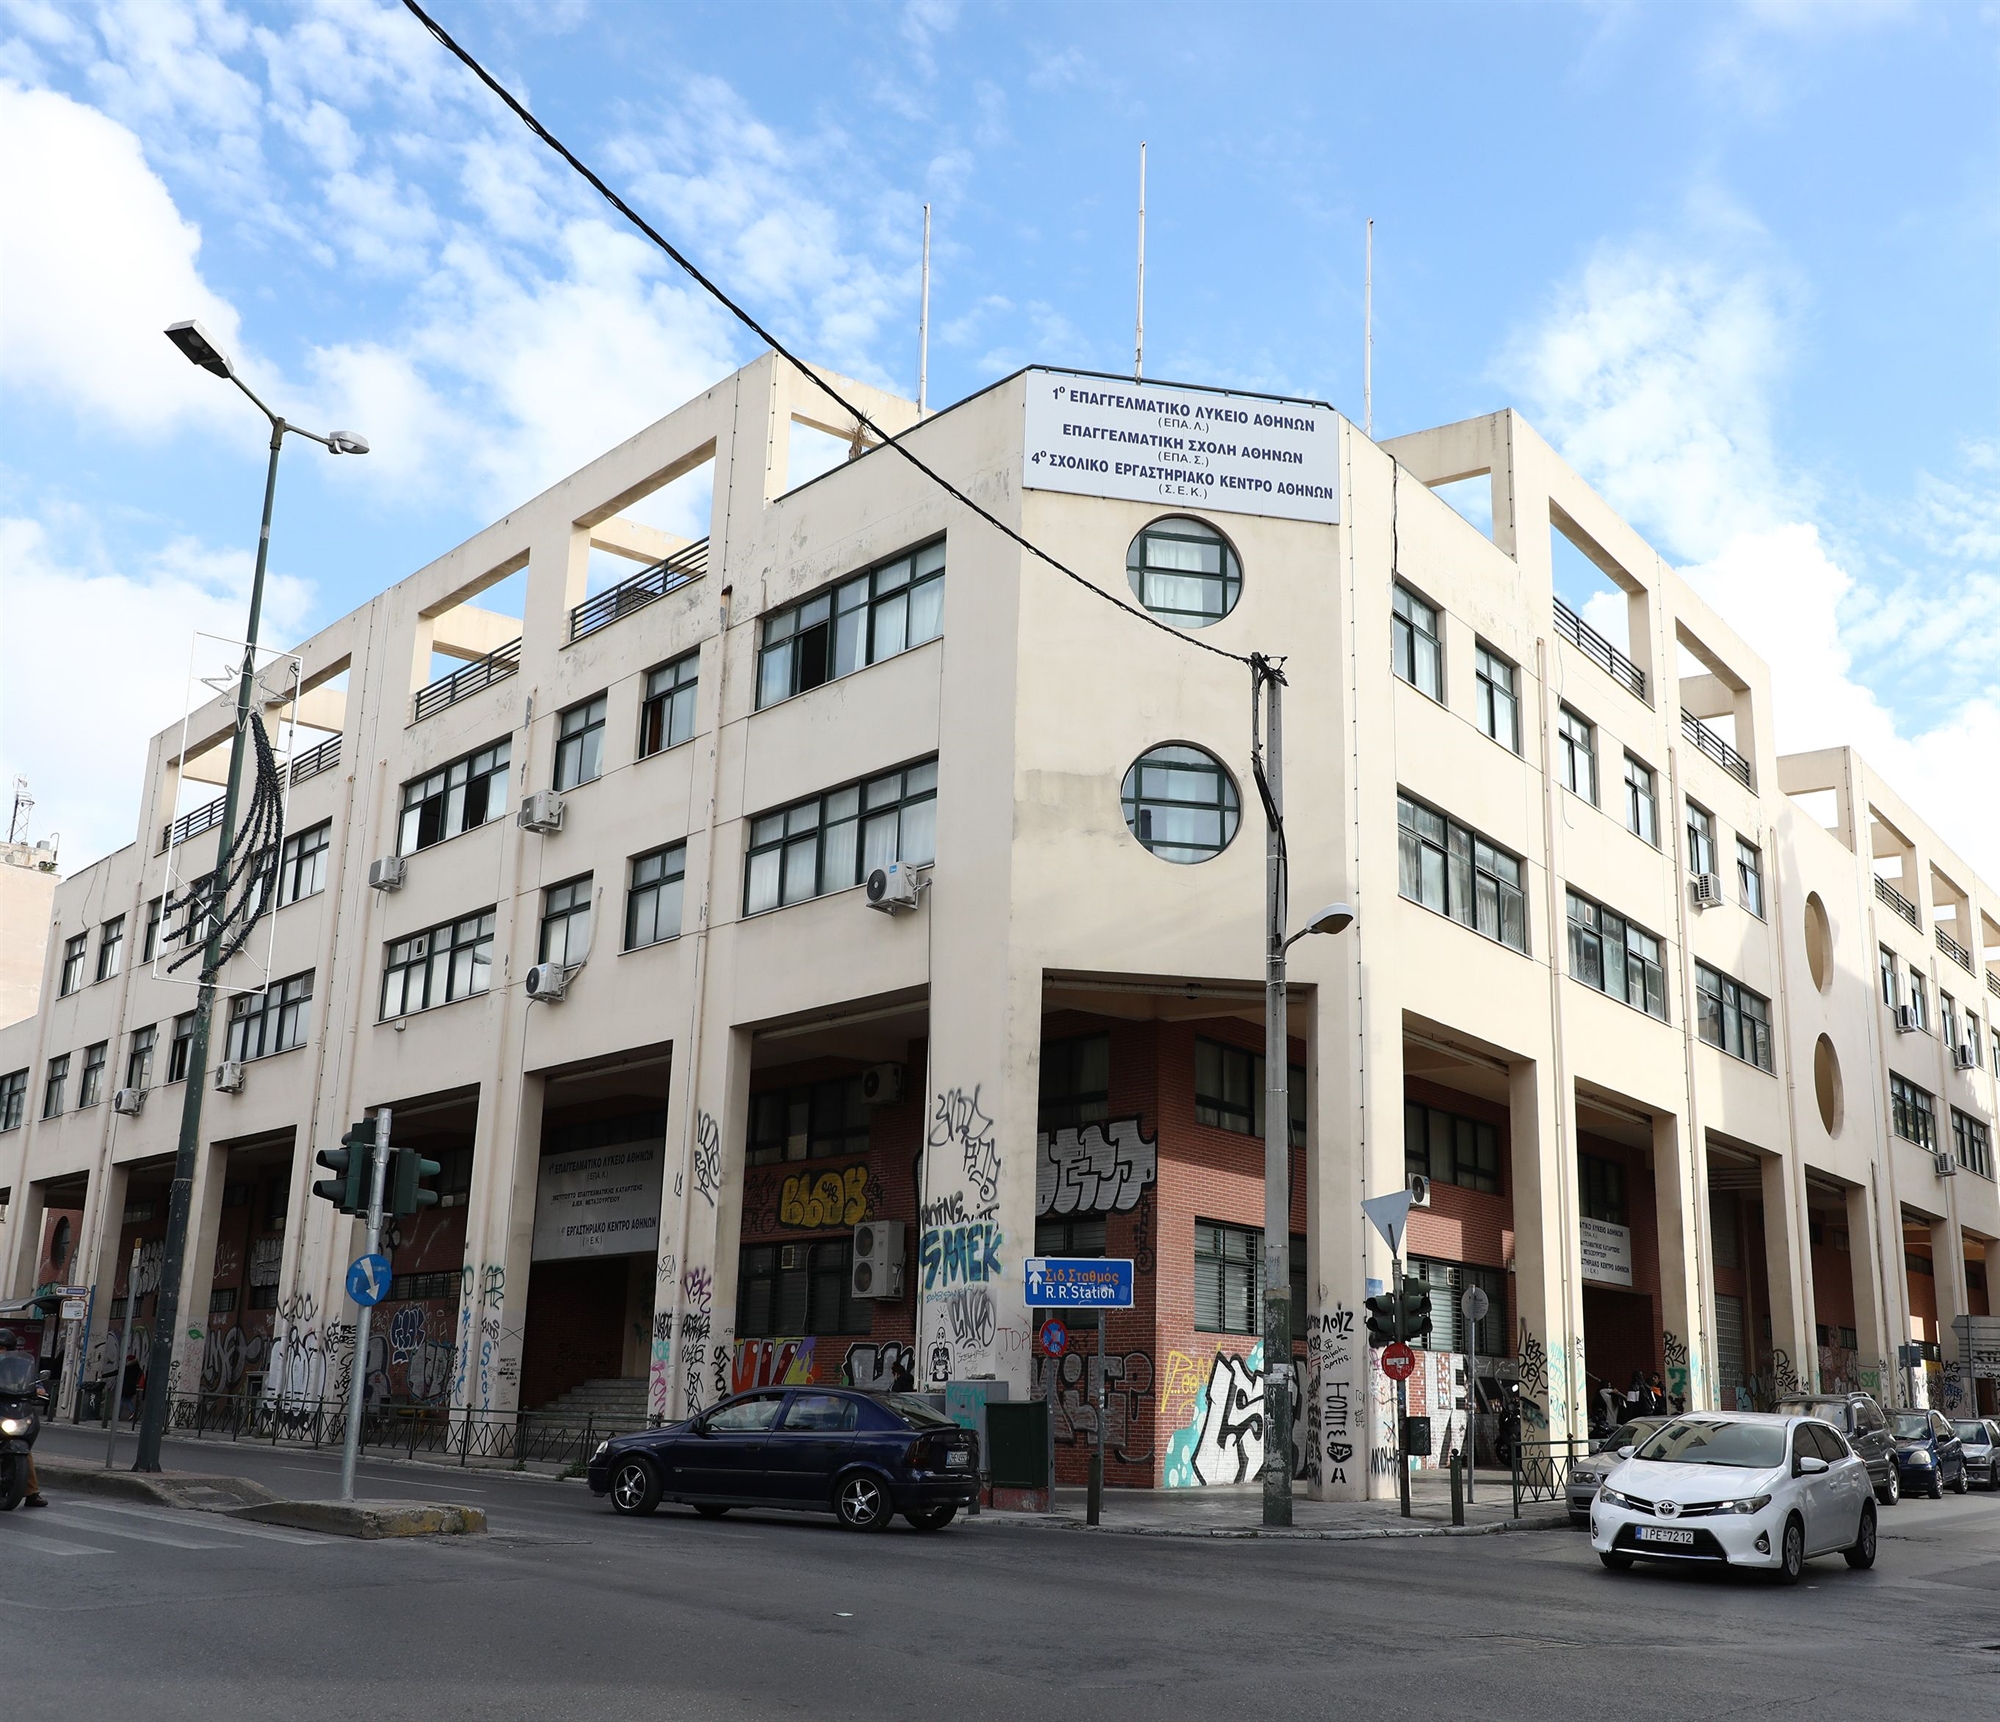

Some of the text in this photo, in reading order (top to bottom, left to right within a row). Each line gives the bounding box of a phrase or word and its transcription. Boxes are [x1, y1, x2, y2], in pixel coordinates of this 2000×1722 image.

[1070, 389, 1191, 417] ΕΠΑΓΓΕΛΜΑΤΙΚΟ
[1195, 406, 1249, 424] ΛΥΚΕΙΟ
[1253, 413, 1315, 432] ΑΘΗΝΩΝ
[1062, 423, 1303, 465] ΕΠΑΓΓΕΛΜΑΤΙΚΗ ΣΧΟΛΗ ΑΘΗΝΩΝ
[1049, 453, 1109, 473] ΣΧΟΛΙΚΟ
[1115, 462, 1215, 486] ΕΡΓΑΣΤΗΡΙΑΚΟ
[1220, 475, 1273, 493] ΚΕΝΤΡΟ
[1277, 481, 1333, 500] ΑΘΗΝΩΝ
[603, 1154, 625, 1166] ΛΥΚΕΙΟ
[626, 1149, 654, 1161] ΑΘΗΝΩΝ
[566, 1222, 606, 1235] ΕΡΓΑΣΤΗΡΙΑΚΟ
[607, 1219, 630, 1231] ΚΕΝΤΡΟ
[631, 1217, 656, 1228] ΑΘΗΝΩΝ
[1045, 1267, 1119, 1285] Σιδ. Σταθμός
[1071, 1285, 1115, 1299] Station
